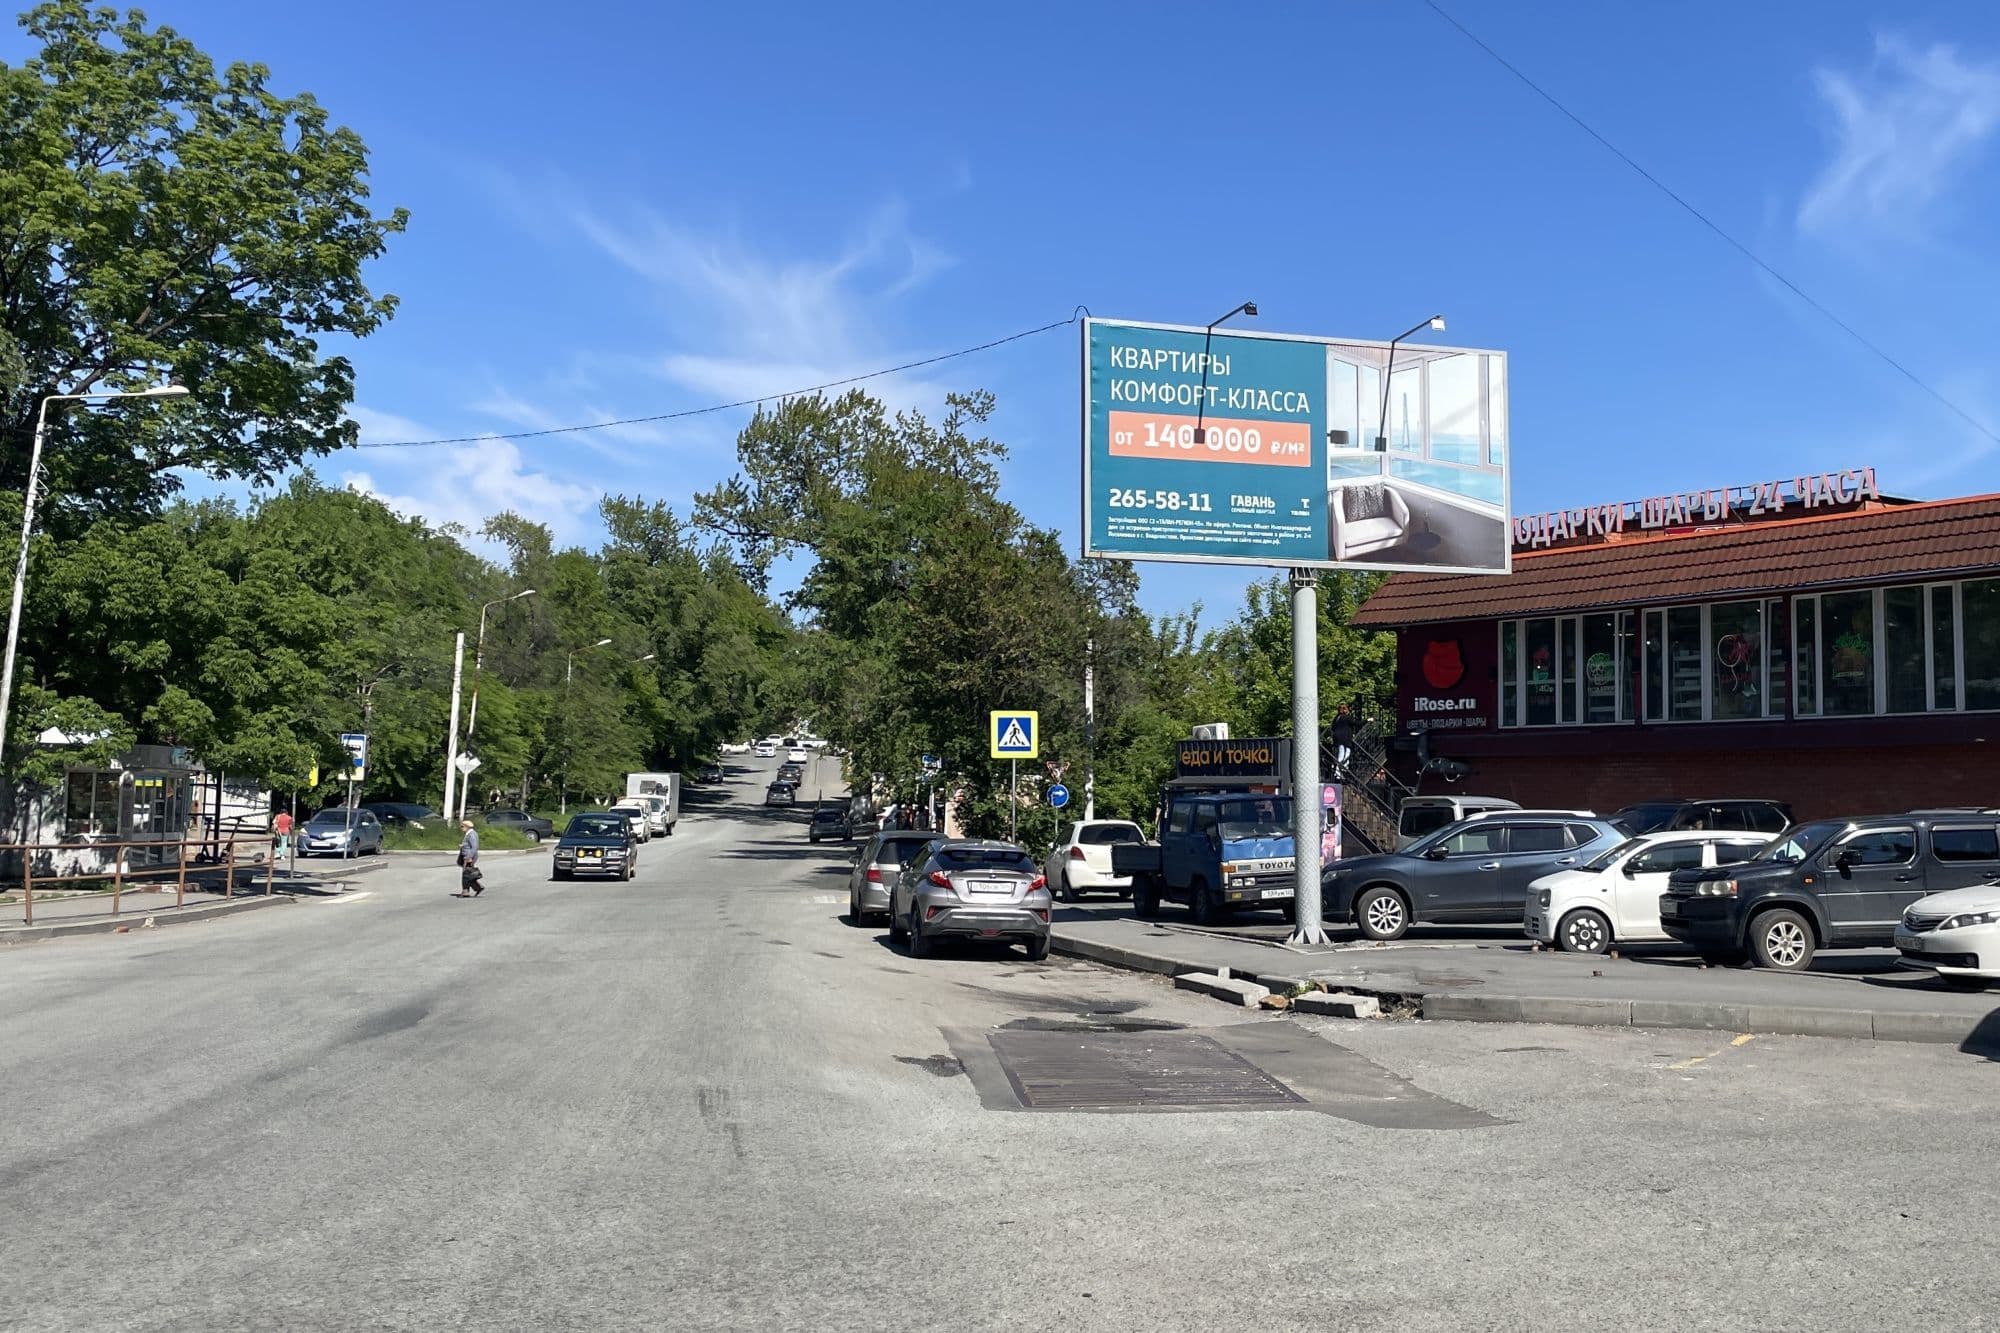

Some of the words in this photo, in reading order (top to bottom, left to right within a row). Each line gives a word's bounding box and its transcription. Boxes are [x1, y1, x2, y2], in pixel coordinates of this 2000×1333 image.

[1111, 346, 1230, 376] КВАРТИРЫ
[1111, 379, 1310, 414] КОМФОРТ-КЛАССА
[1144, 422, 1195, 450] 140
[1204, 426, 1261, 454] 000
[1109, 488, 1212, 512] 265-58-11
[1230, 494, 1276, 509] ГАВАНЬ
[1640, 487, 1728, 529] ШАРЫ
[1750, 480, 1784, 516] 24
[1793, 466, 1880, 509] ЧАСА
[1414, 697, 1477, 712] iRose.ru
[1181, 751, 1210, 767] еда
[1213, 750, 1223, 764] и
[1226, 747, 1273, 764] точка.
[1259, 861, 1296, 870] TOYOTA
